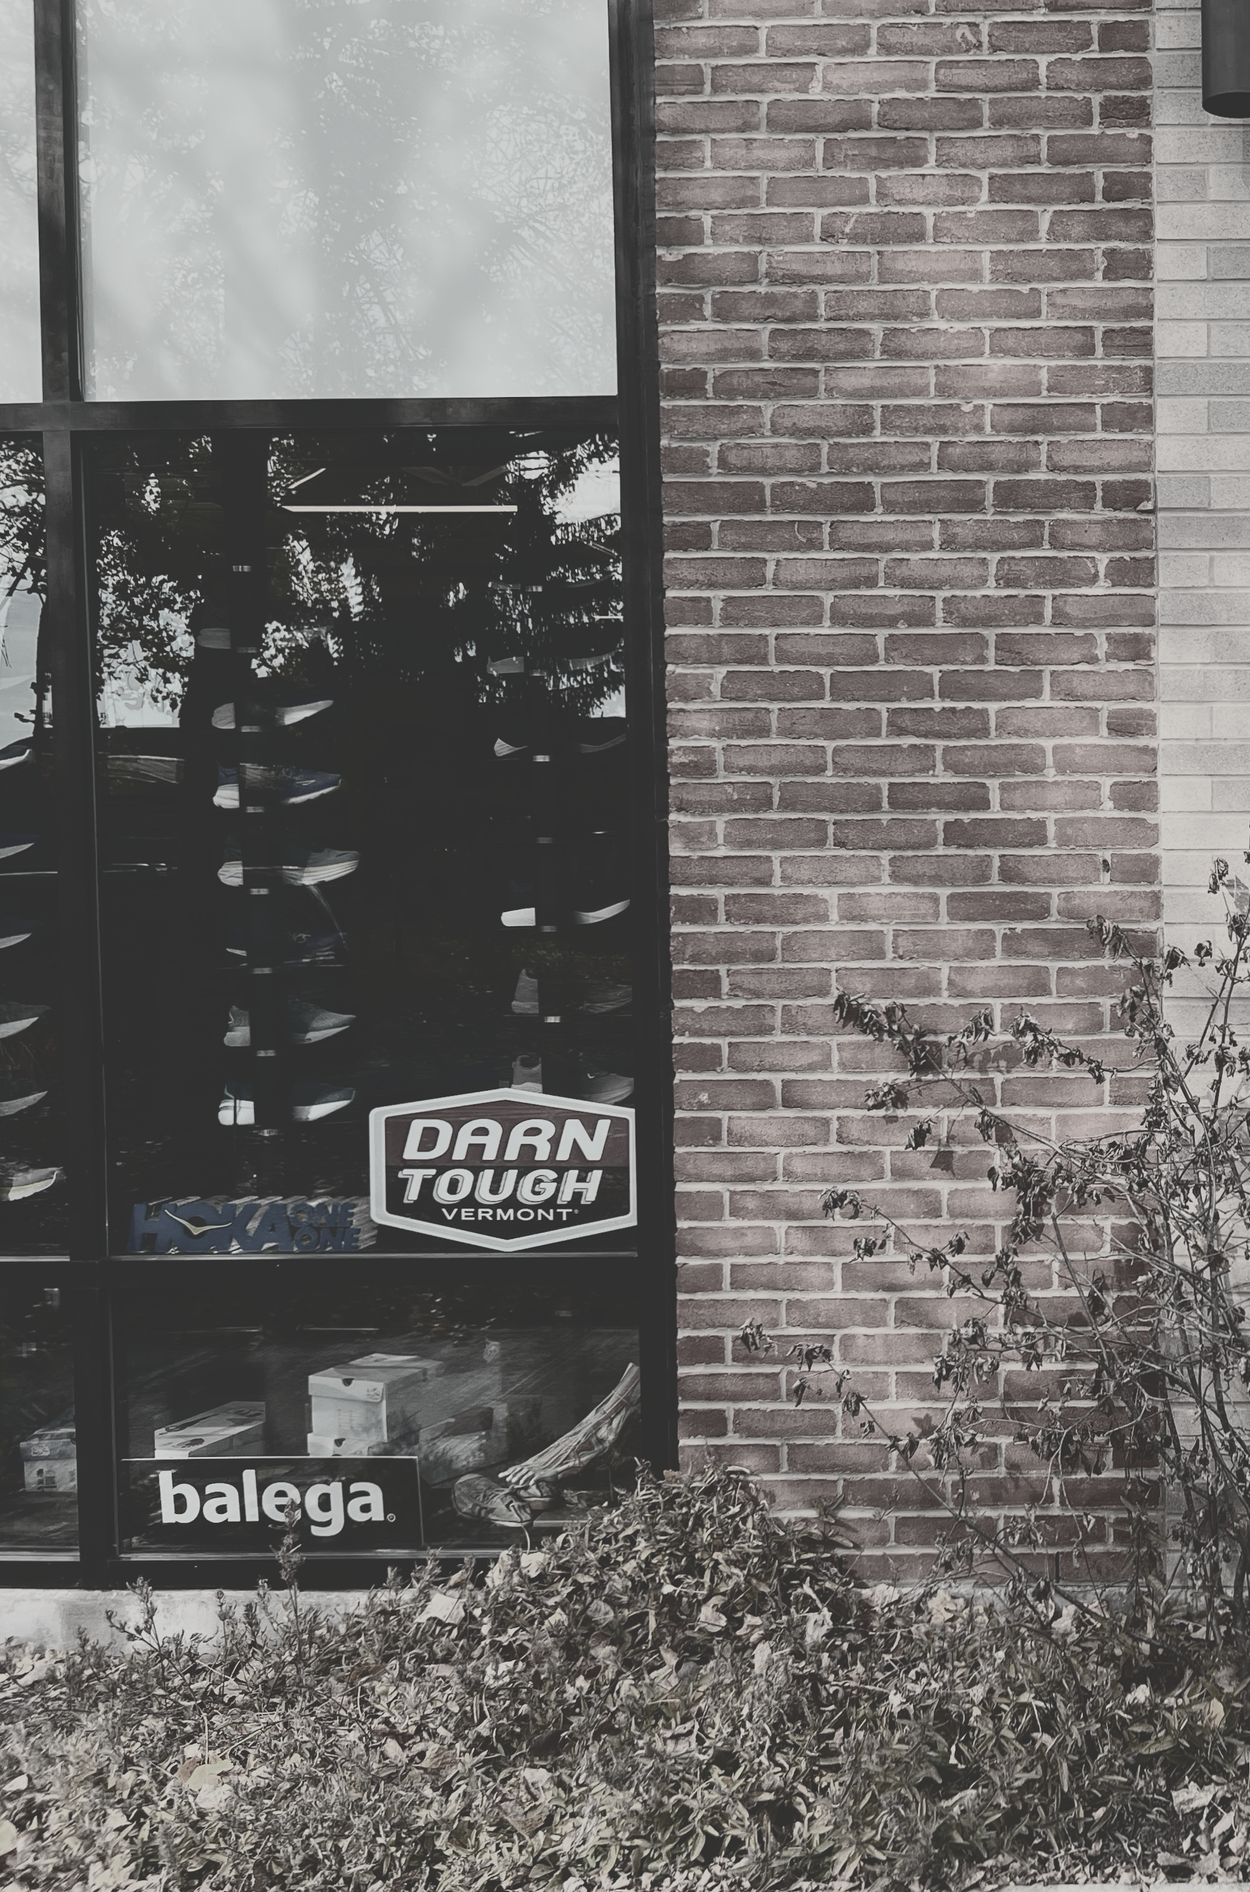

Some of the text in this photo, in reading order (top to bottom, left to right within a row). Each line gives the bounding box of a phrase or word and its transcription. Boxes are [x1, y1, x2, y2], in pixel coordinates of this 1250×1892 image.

[402, 1118, 612, 1161] DARN
[398, 1168, 604, 1205] TOUGH
[128, 1202, 355, 1252] HOKA ONE
[441, 1208, 573, 1221] VERMONT
[294, 1228, 361, 1251] ONE
[158, 1468, 386, 1537] balega
